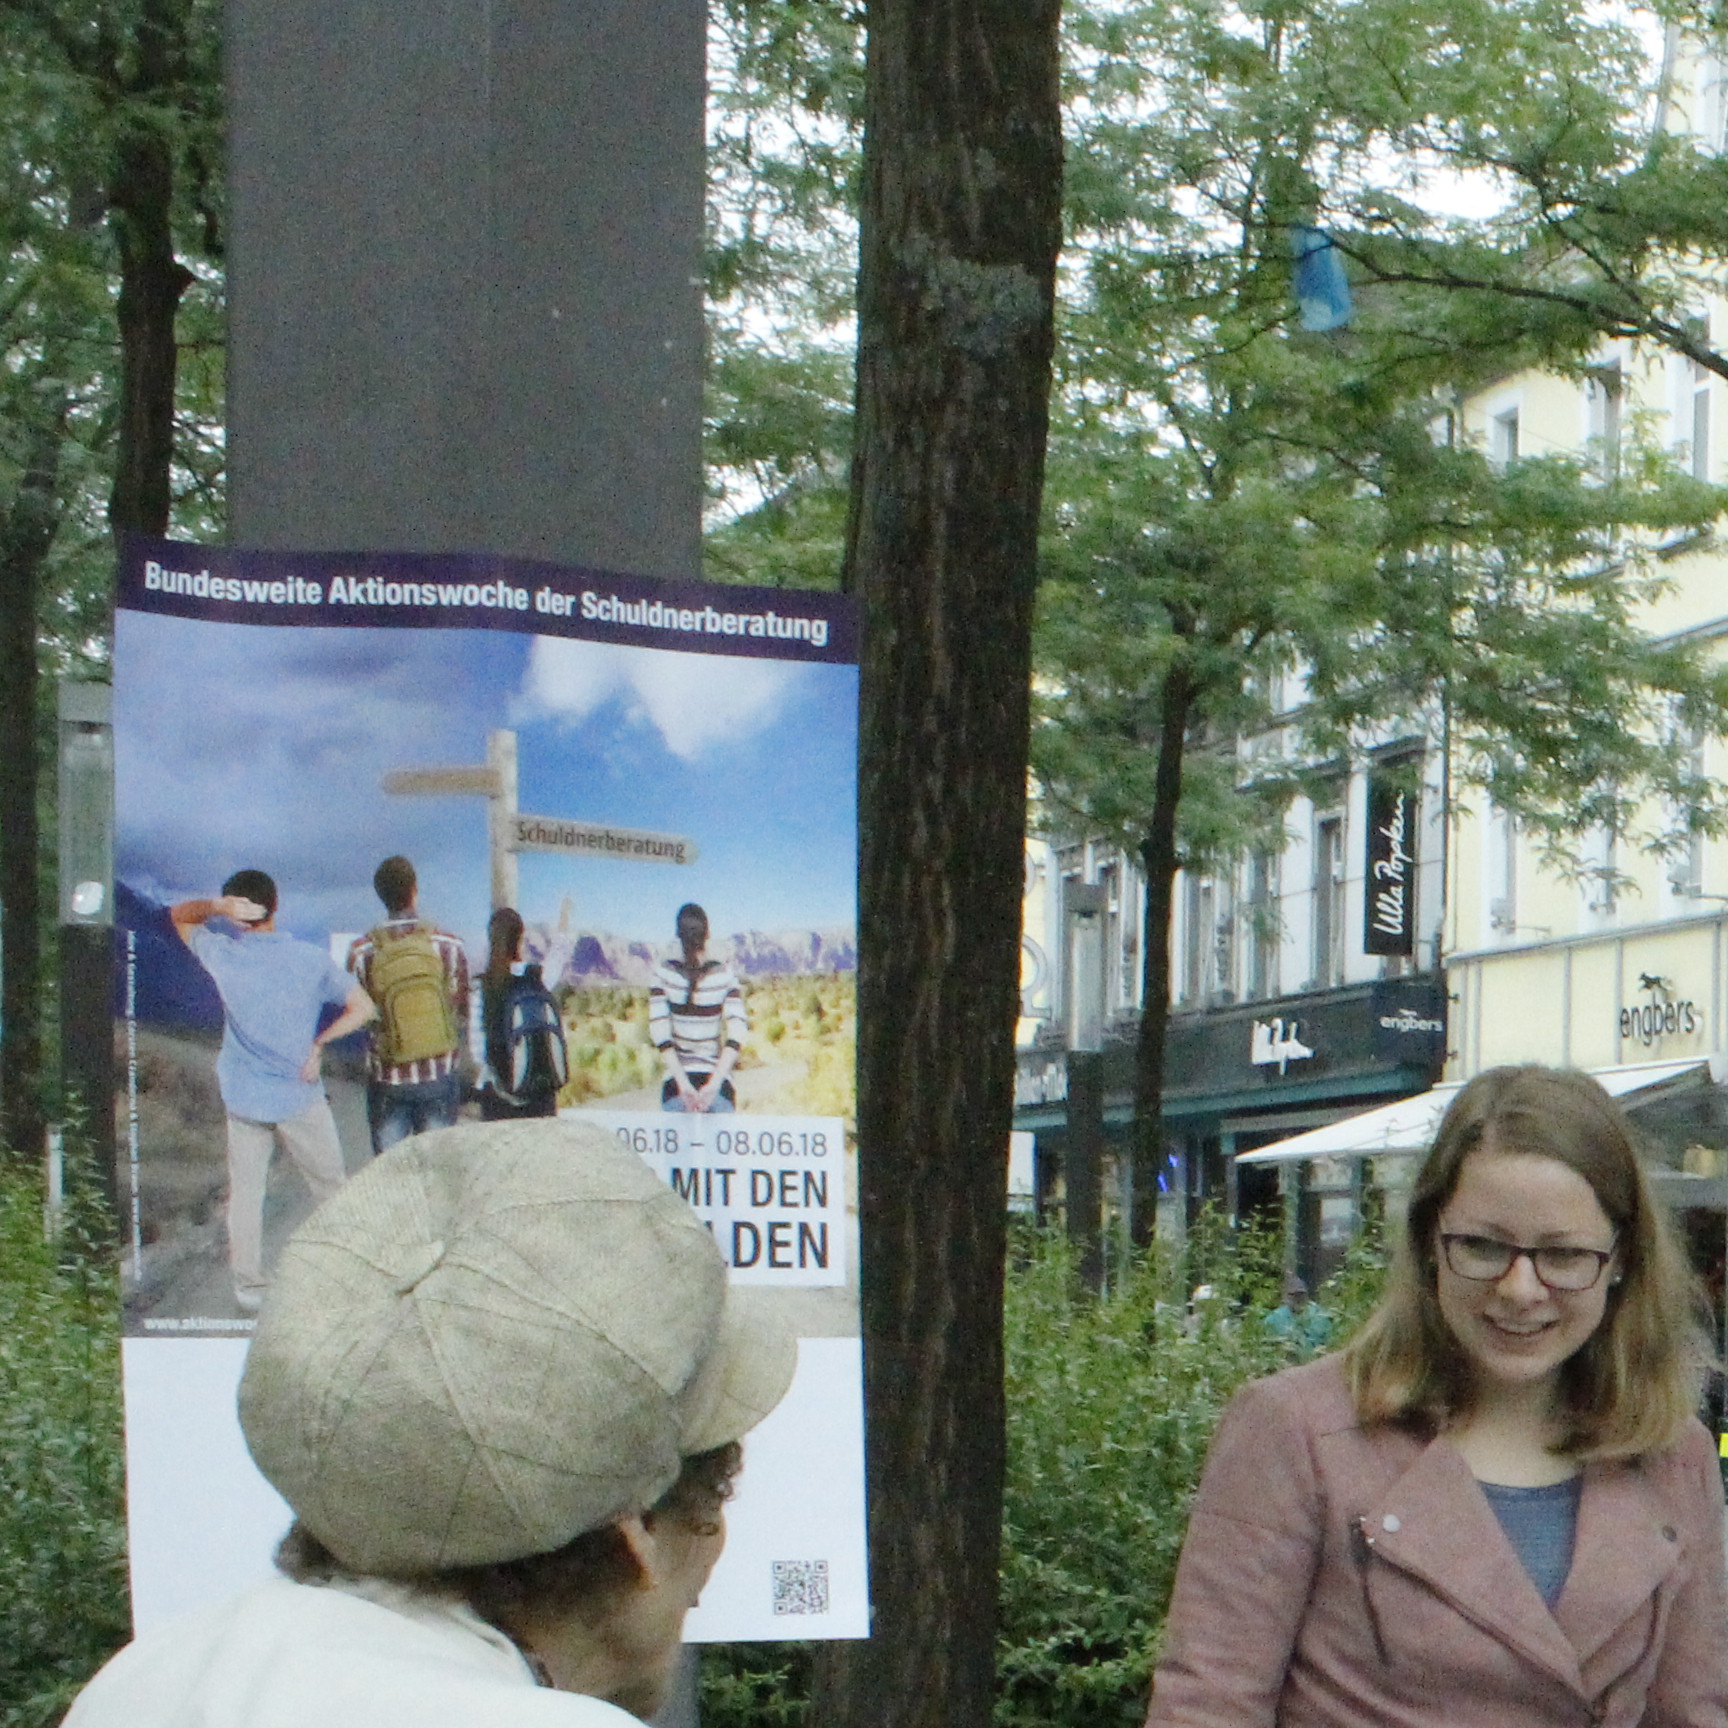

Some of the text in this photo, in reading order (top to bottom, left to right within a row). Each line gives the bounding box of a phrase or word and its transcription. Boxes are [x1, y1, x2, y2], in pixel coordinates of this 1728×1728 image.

[144, 560, 829, 647] Bundesweite Aktionswoche der Schuldnerberatung
[515, 818, 686, 864] Schuldnerberatung
[1372, 789, 1414, 937] Ulla Popken
[1380, 1015, 1444, 1033] engbers
[1619, 998, 1697, 1047] engbers
[616, 1126, 679, 1154] 06.18
[715, 1129, 828, 1157] 08.06.18
[671, 1166, 829, 1209] MIT DEN
[725, 1220, 829, 1270] DEN
